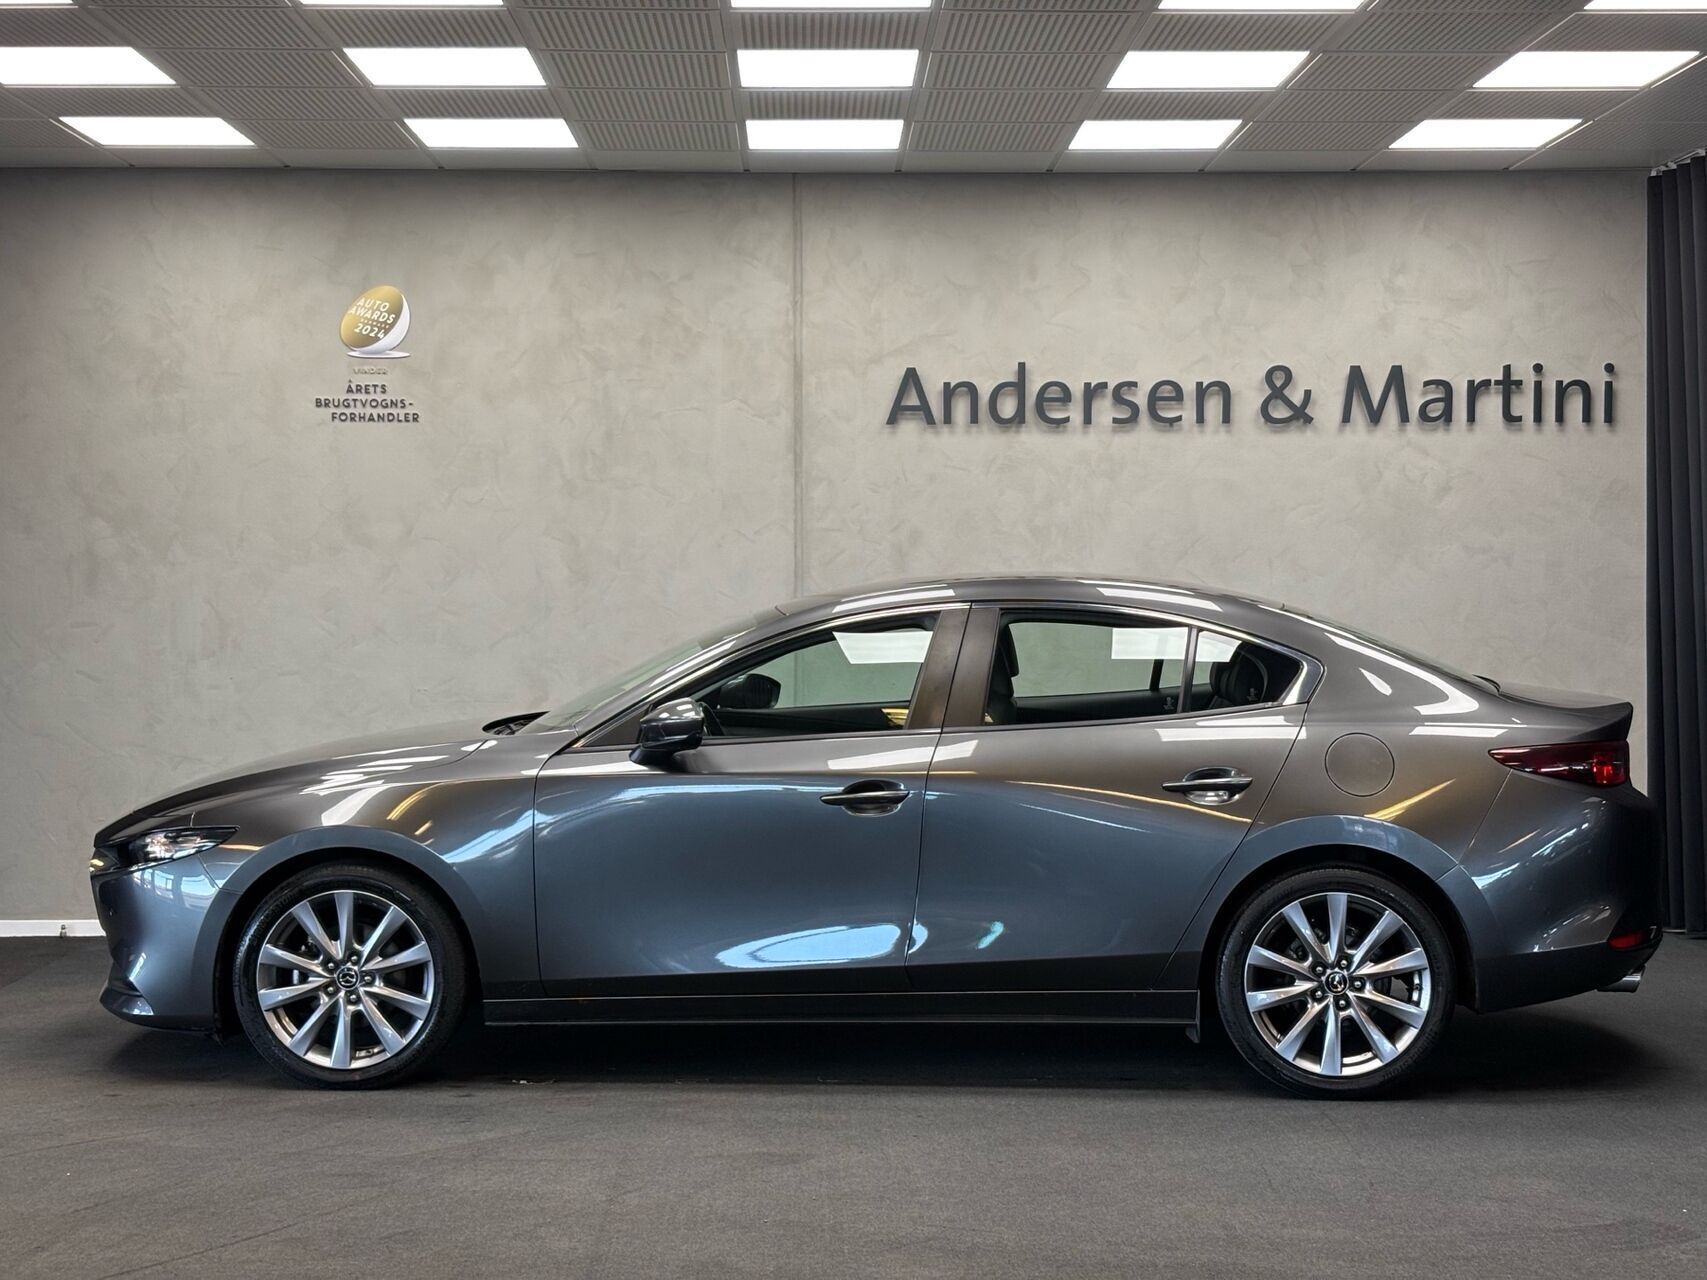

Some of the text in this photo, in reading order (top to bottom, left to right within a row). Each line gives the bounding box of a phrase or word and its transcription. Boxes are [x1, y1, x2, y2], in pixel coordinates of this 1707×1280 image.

[356, 297, 390, 312] AUTO
[348, 306, 396, 324] AWARDS
[353, 323, 386, 339] 2024
[346, 380, 387, 394] ÅRETS
[886, 361, 1615, 426] Andersen & Martini
[315, 397, 414, 409] BRUGTVOGNS-
[331, 412, 420, 423] FORHANDLER
